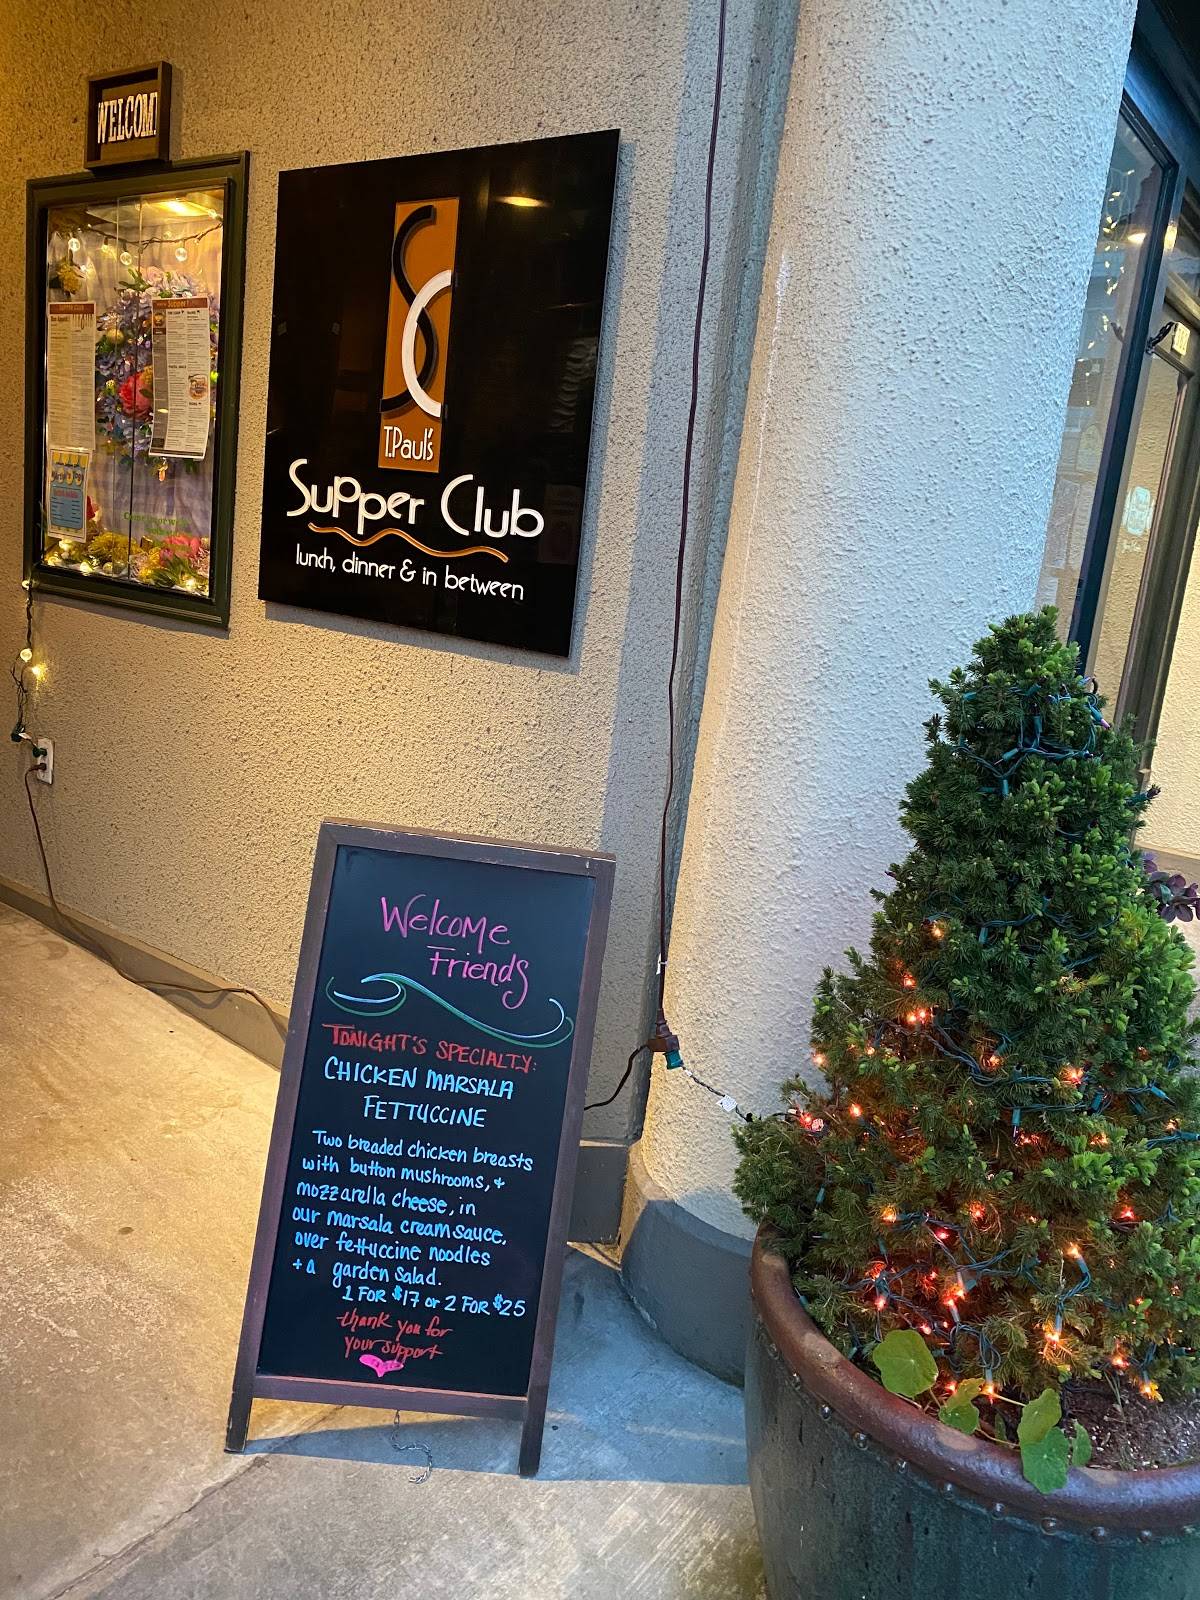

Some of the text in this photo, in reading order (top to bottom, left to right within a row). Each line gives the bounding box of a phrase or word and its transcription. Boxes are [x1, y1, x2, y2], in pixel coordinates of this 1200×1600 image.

[286, 458, 545, 538] Supper Club
[295, 543, 524, 600] lunch, dinner & in between
[426, 945, 529, 1010] Friends
[322, 1023, 428, 1055] TONIGHT'S
[323, 1055, 515, 1100] CHICKEN MARSALA
[363, 1094, 487, 1128] FETTUCCINE
[312, 1130, 534, 1171] Two breaded chicken breasts
[302, 1154, 339, 1173] with
[349, 1158, 396, 1179] button
[401, 1167, 490, 1192] mushrooms,
[296, 1181, 476, 1217] mozzarella cheese, in
[292, 1206, 321, 1223] our
[327, 1209, 393, 1235] marsala
[400, 1221, 451, 1238] cream
[294, 1231, 491, 1266] over fettuccine noodles
[332, 1260, 389, 1288] garden
[342, 1285, 526, 1317] 1 FOR $17 or 2 FOR $25
[336, 1307, 454, 1342] thank you for
[344, 1336, 444, 1364] your support
